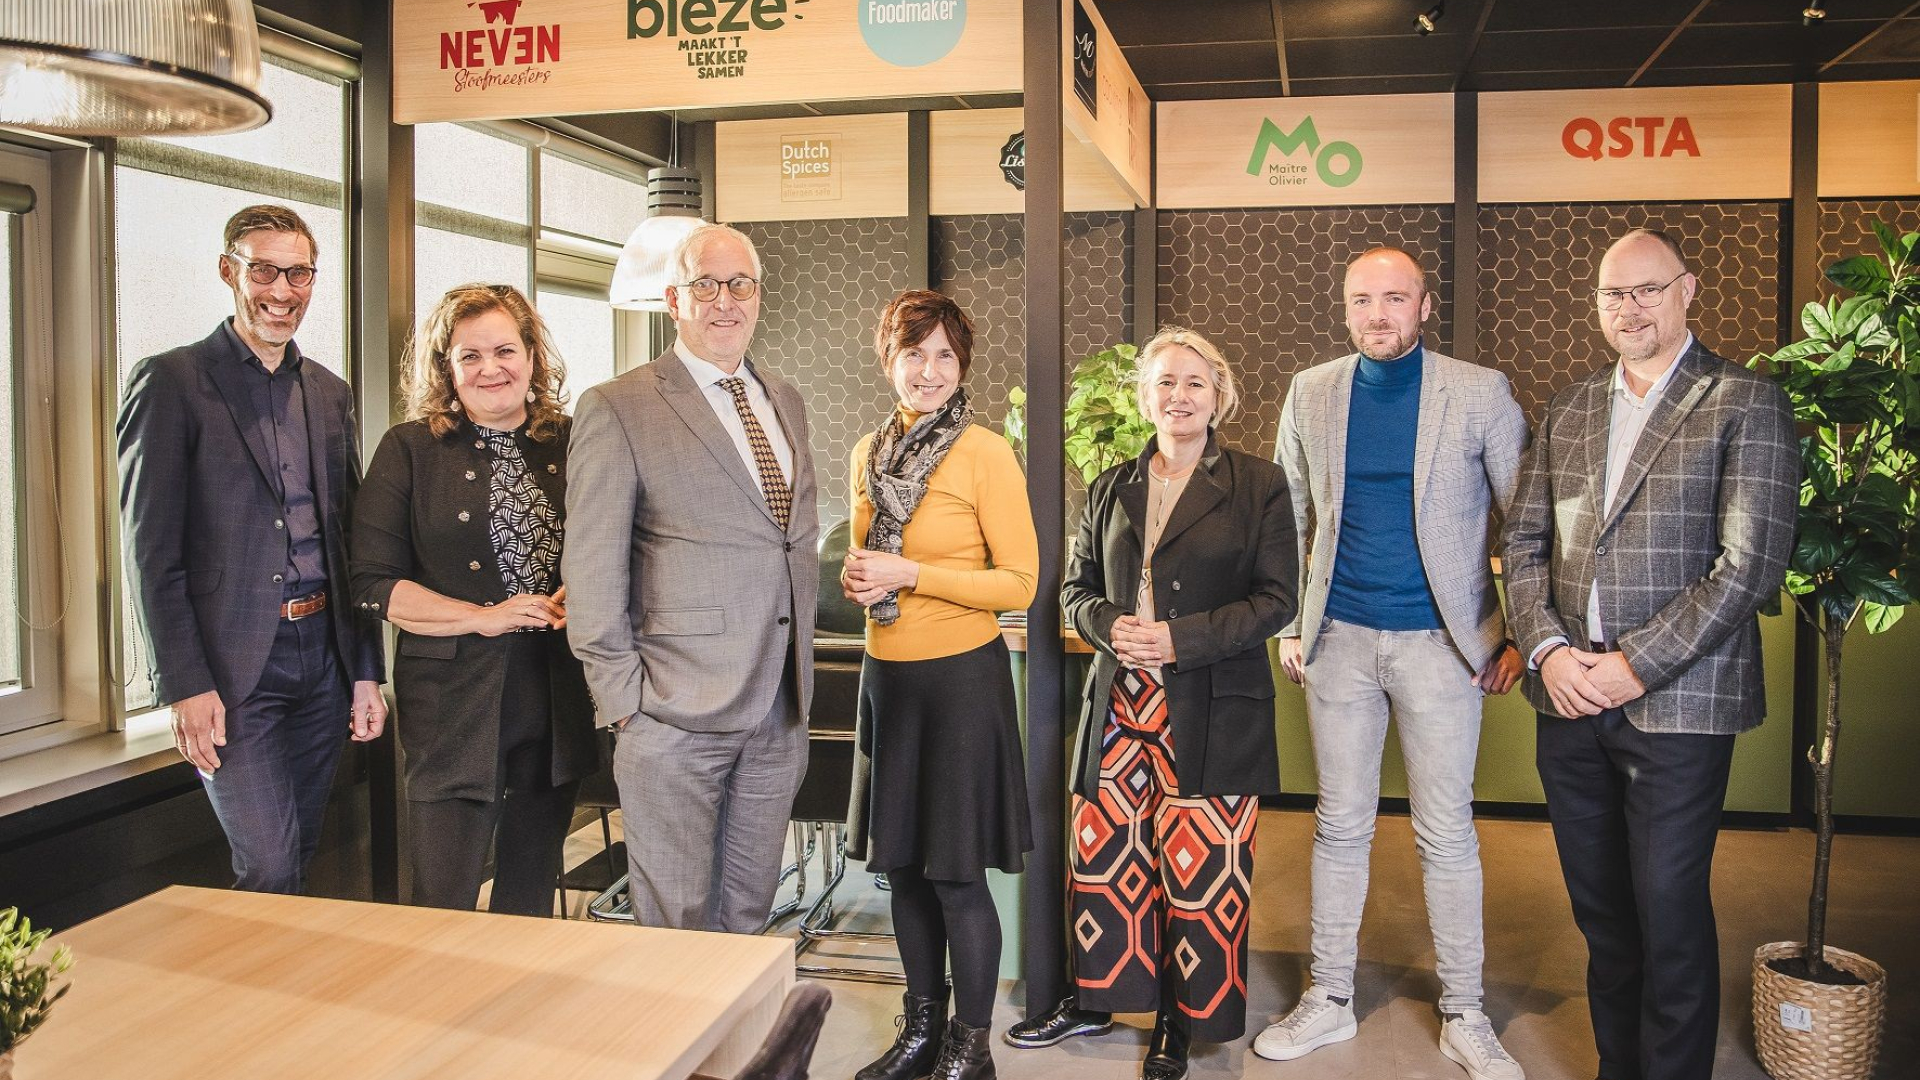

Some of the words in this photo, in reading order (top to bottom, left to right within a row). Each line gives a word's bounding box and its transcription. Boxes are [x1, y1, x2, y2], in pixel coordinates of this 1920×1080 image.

[627, 0, 787, 39] bieze
[868, 0, 957, 24] Foodmaker
[440, 24, 560, 69] NEVEN
[678, 37, 726, 51] MAAKT
[687, 50, 748, 66] LEKKER
[454, 66, 551, 92] Stoofmeesters
[698, 66, 744, 79] SAMEN
[1561, 117, 1701, 161] QSTA
[782, 140, 829, 160] Dutch
[782, 161, 830, 179] Spices
[1269, 176, 1307, 185] Olivier
